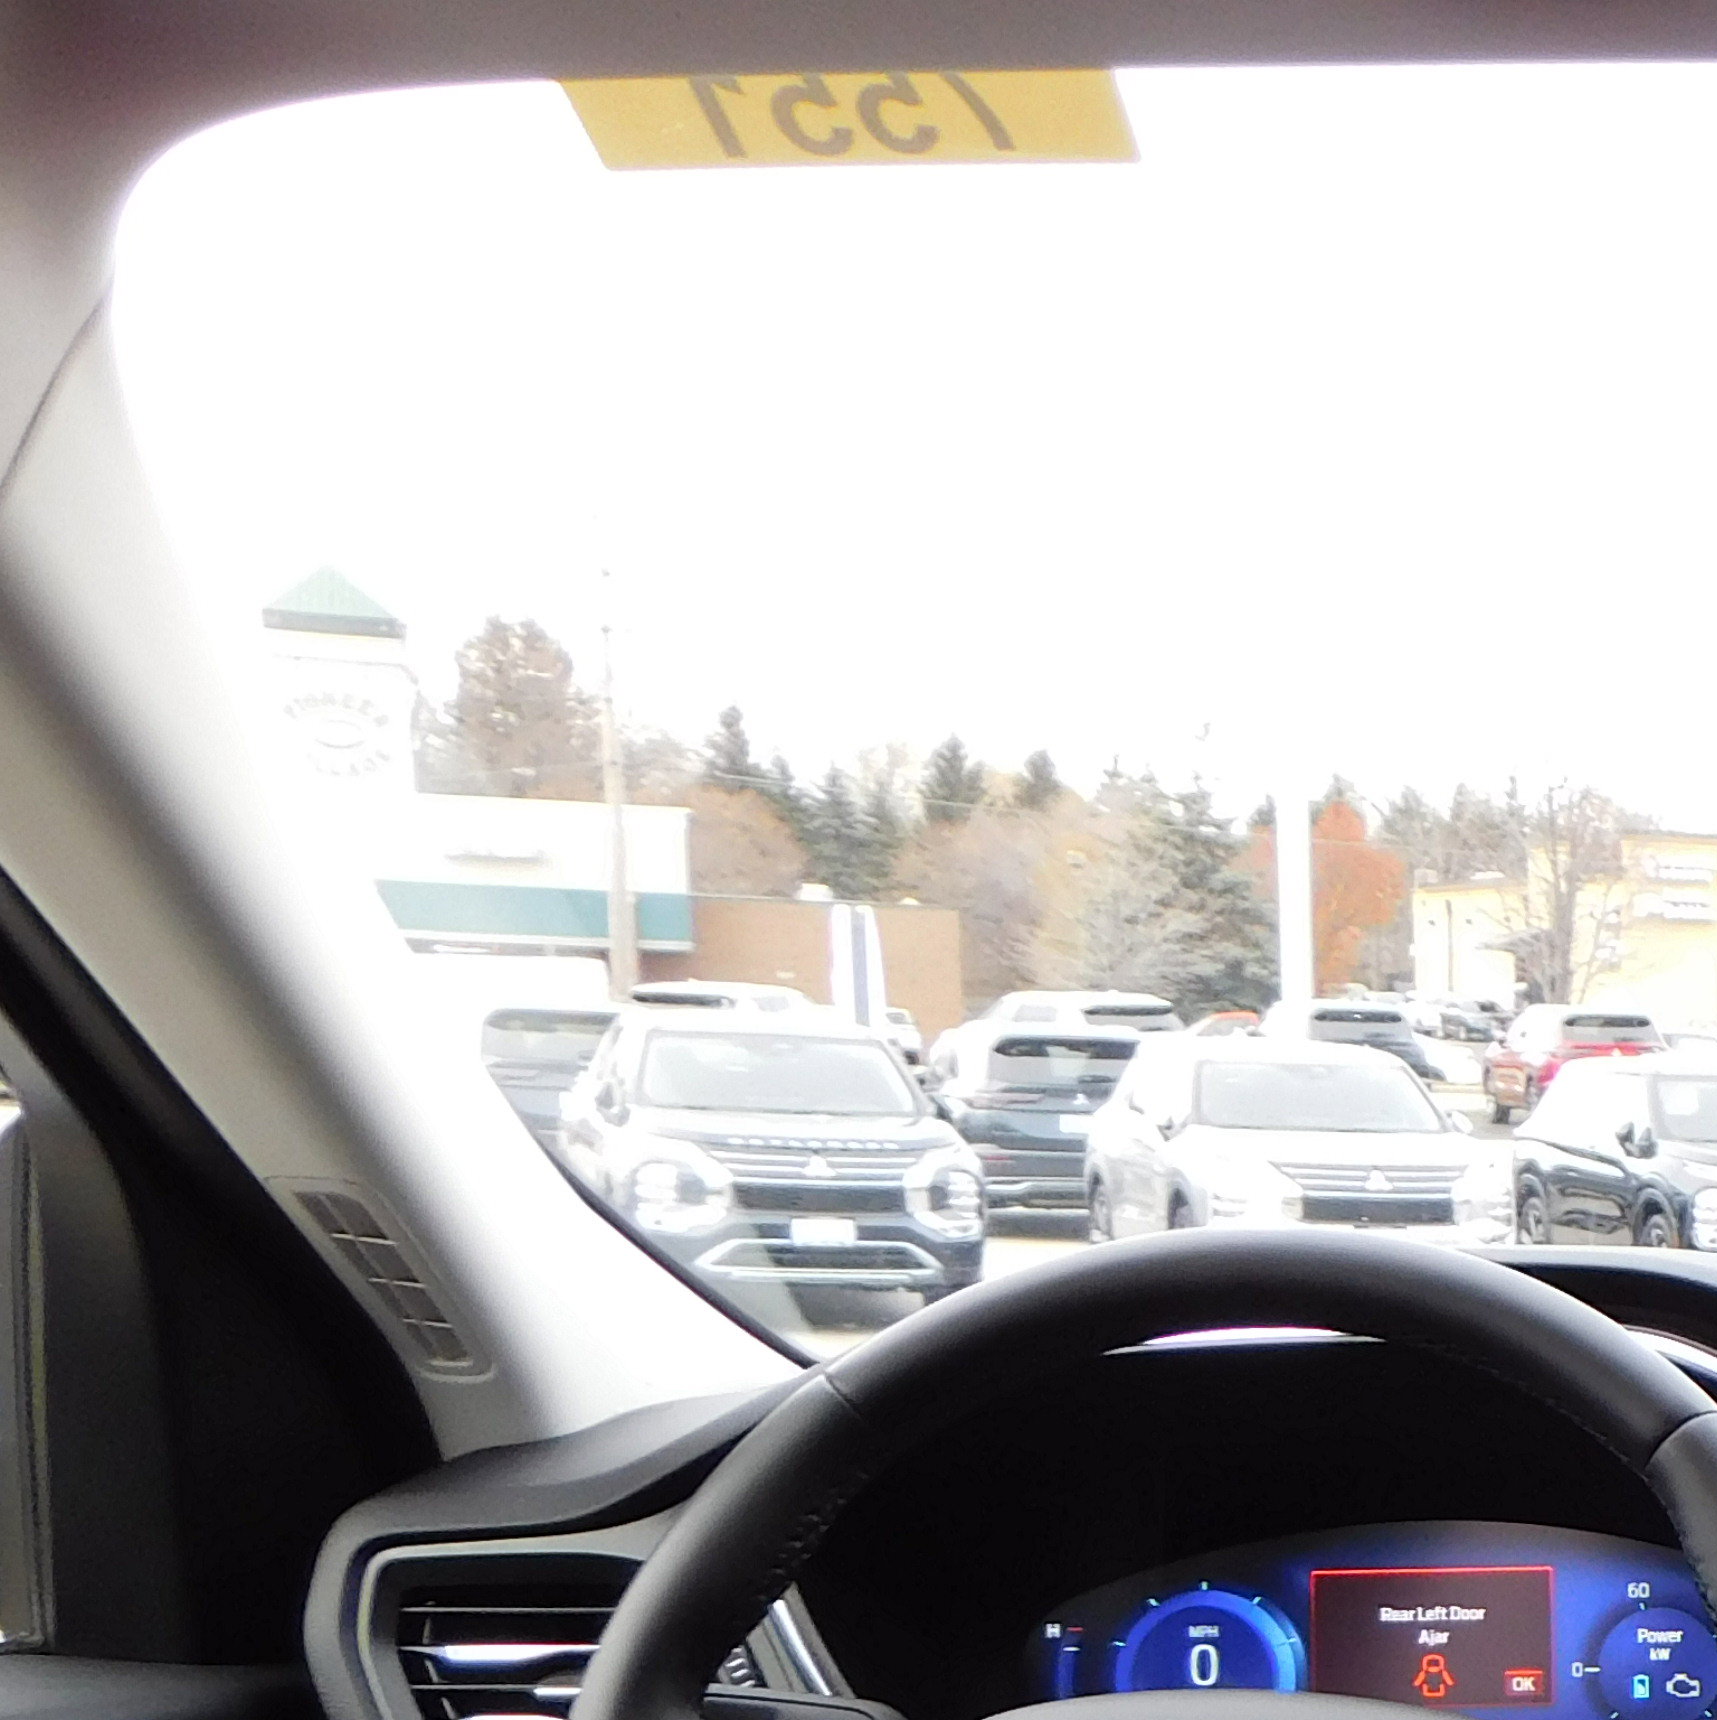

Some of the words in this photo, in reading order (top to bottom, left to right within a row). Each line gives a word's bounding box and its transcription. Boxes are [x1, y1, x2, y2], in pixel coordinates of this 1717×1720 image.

[1627, 1581, 1650, 1599] 60
[1379, 1606, 1415, 1622] Rear
[1417, 1605, 1449, 1621] Left
[1450, 1605, 1487, 1621] Door
[1418, 1629, 1450, 1646] Ajar
[1637, 1627, 1685, 1644] Power
[1649, 1647, 1672, 1661] kW
[1190, 1643, 1220, 1687] 0
[1511, 1676, 1536, 1692] OK
